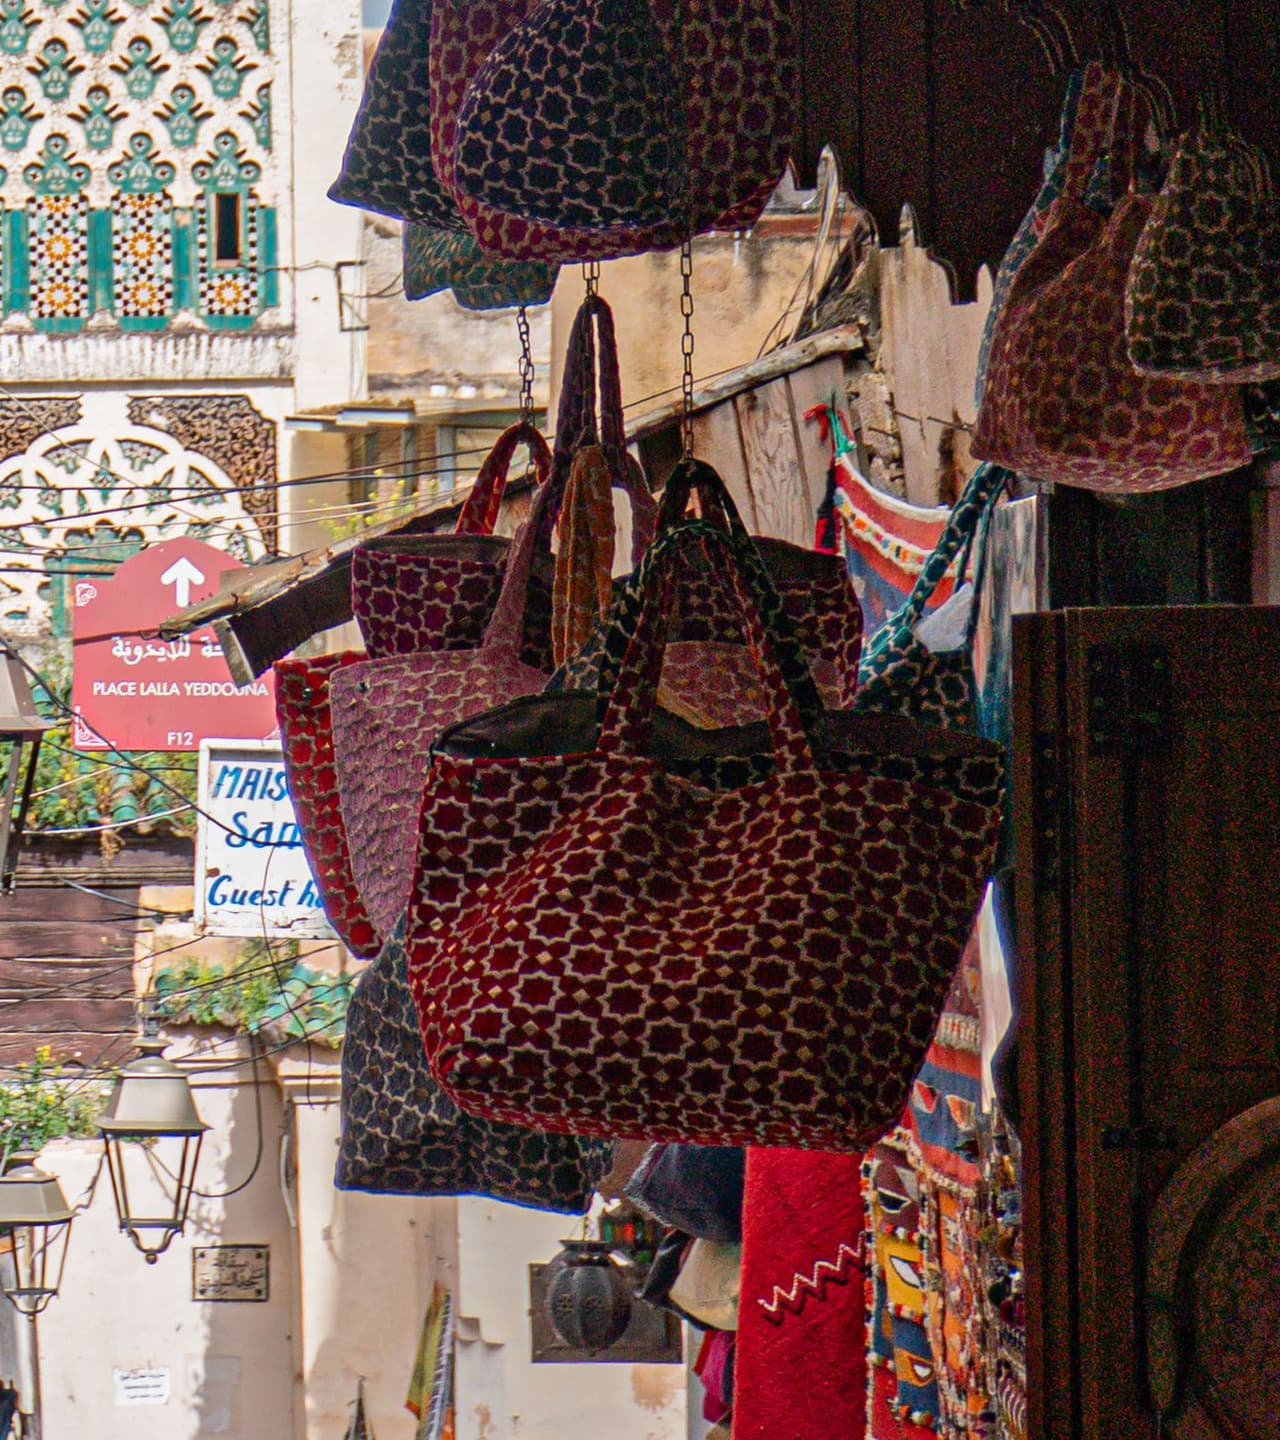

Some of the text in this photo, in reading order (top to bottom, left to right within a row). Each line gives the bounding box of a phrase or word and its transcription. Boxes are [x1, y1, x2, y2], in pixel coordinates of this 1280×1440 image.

[92, 681, 269, 697] PLACE LALLA YEDDOUNA
[167, 732, 194, 746] F12
[208, 875, 295, 907] Guest
